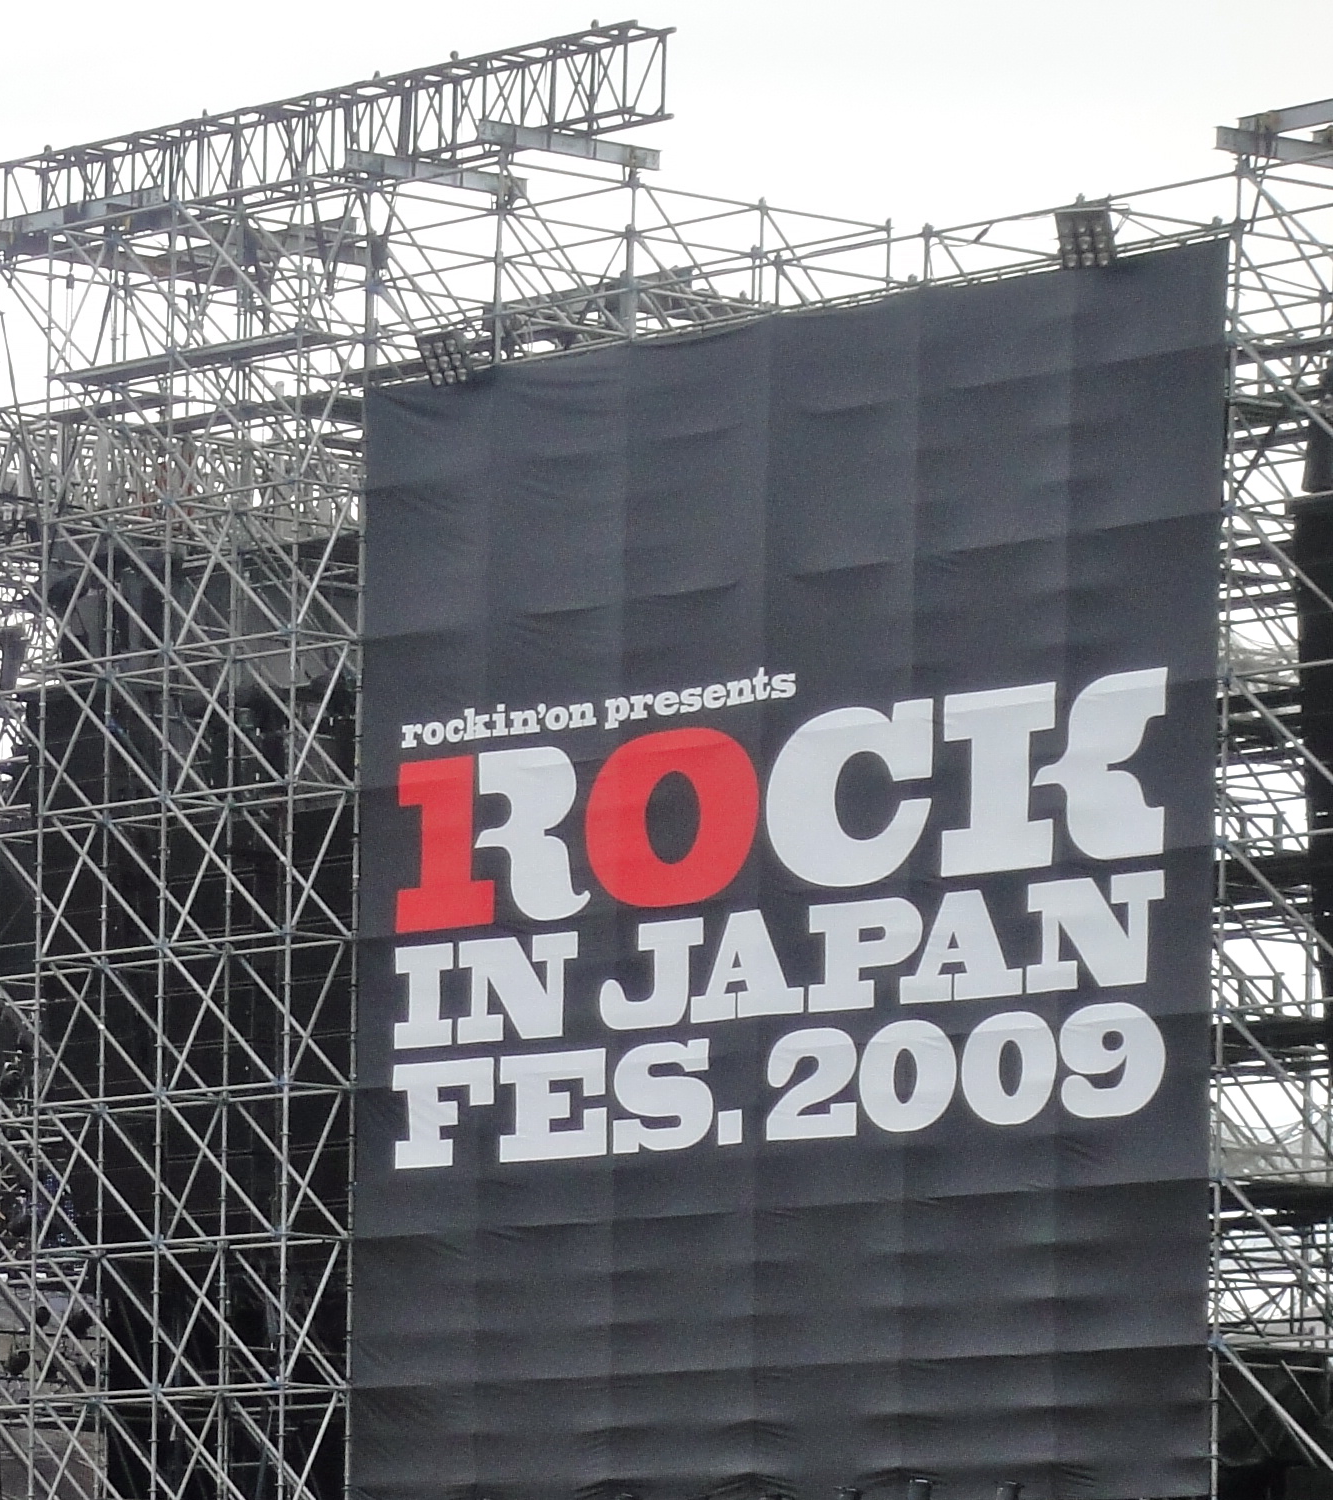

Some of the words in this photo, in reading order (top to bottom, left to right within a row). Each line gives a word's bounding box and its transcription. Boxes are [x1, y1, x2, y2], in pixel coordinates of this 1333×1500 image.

[401, 703, 597, 749] rockin'on
[604, 667, 797, 730] presents
[393, 931, 579, 1049] IN
[599, 870, 1166, 1031] JAPAN
[392, 1038, 744, 1169] FES.
[765, 1002, 1168, 1141] 2009
